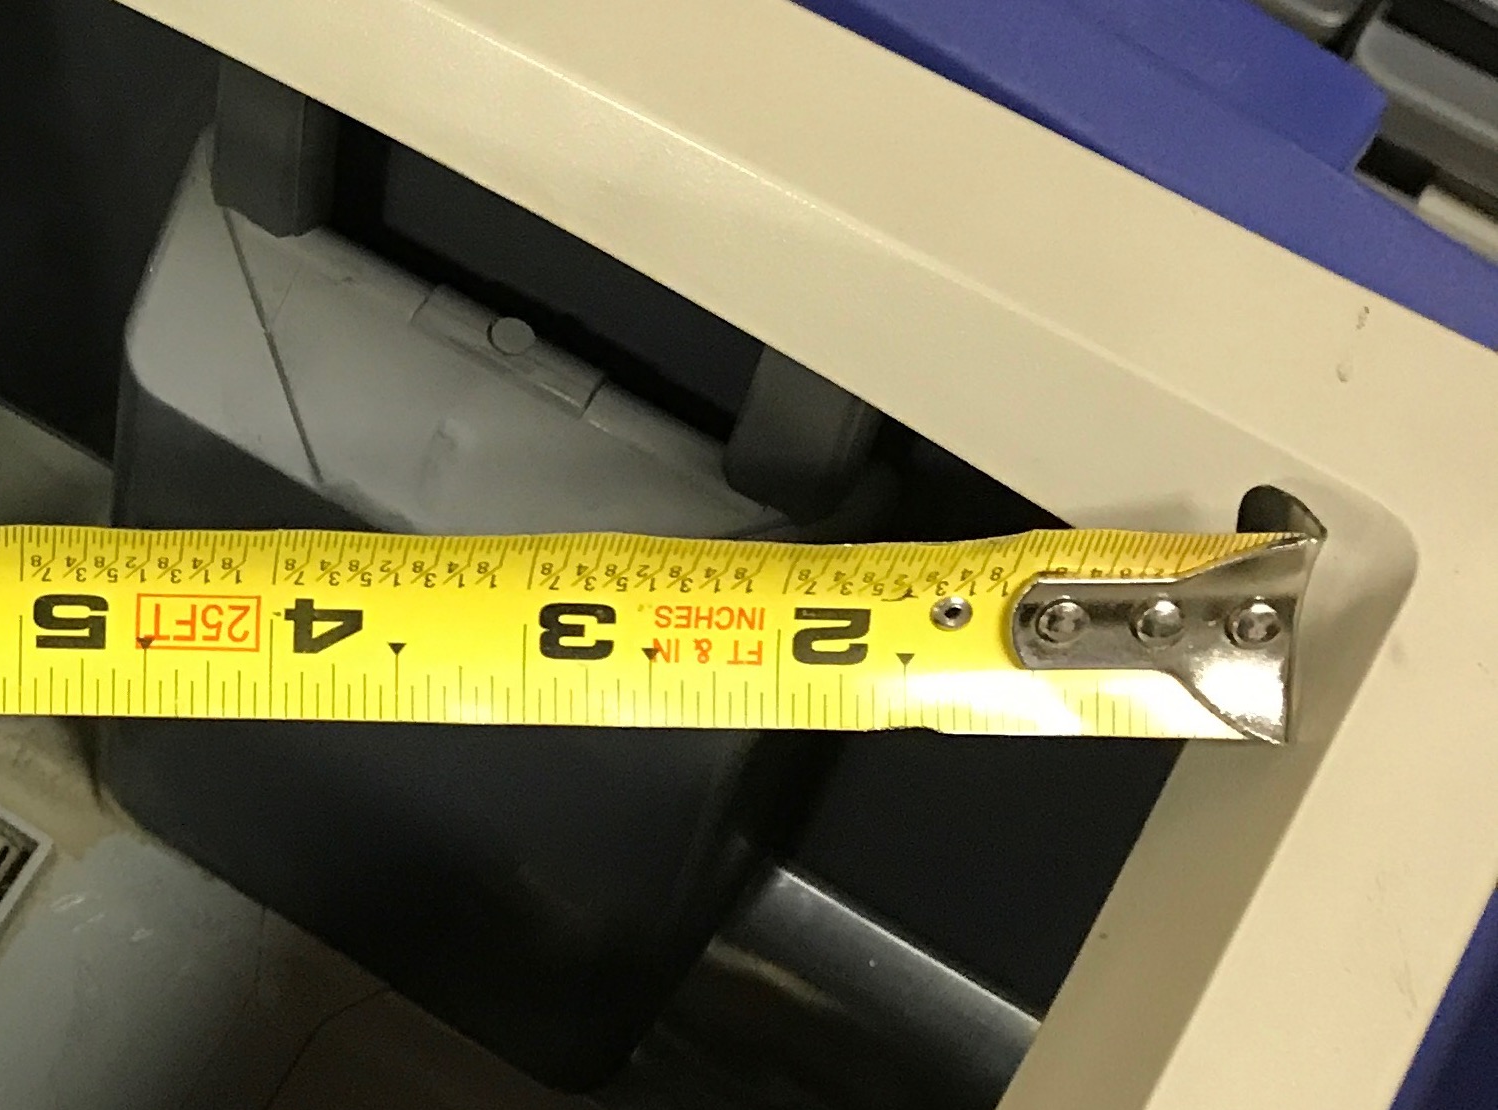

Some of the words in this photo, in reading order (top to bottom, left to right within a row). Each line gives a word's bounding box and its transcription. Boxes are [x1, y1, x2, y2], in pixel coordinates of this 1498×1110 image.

[34, 594, 108, 650] 5
[142, 604, 250, 644] 25FT
[284, 598, 362, 654] 4
[540, 602, 616, 660] 3
[654, 606, 766, 630] INCHES
[794, 608, 870, 664] 2
[652, 638, 680, 664] IN
[694, 638, 712, 664] &
[726, 640, 764, 666] FT
